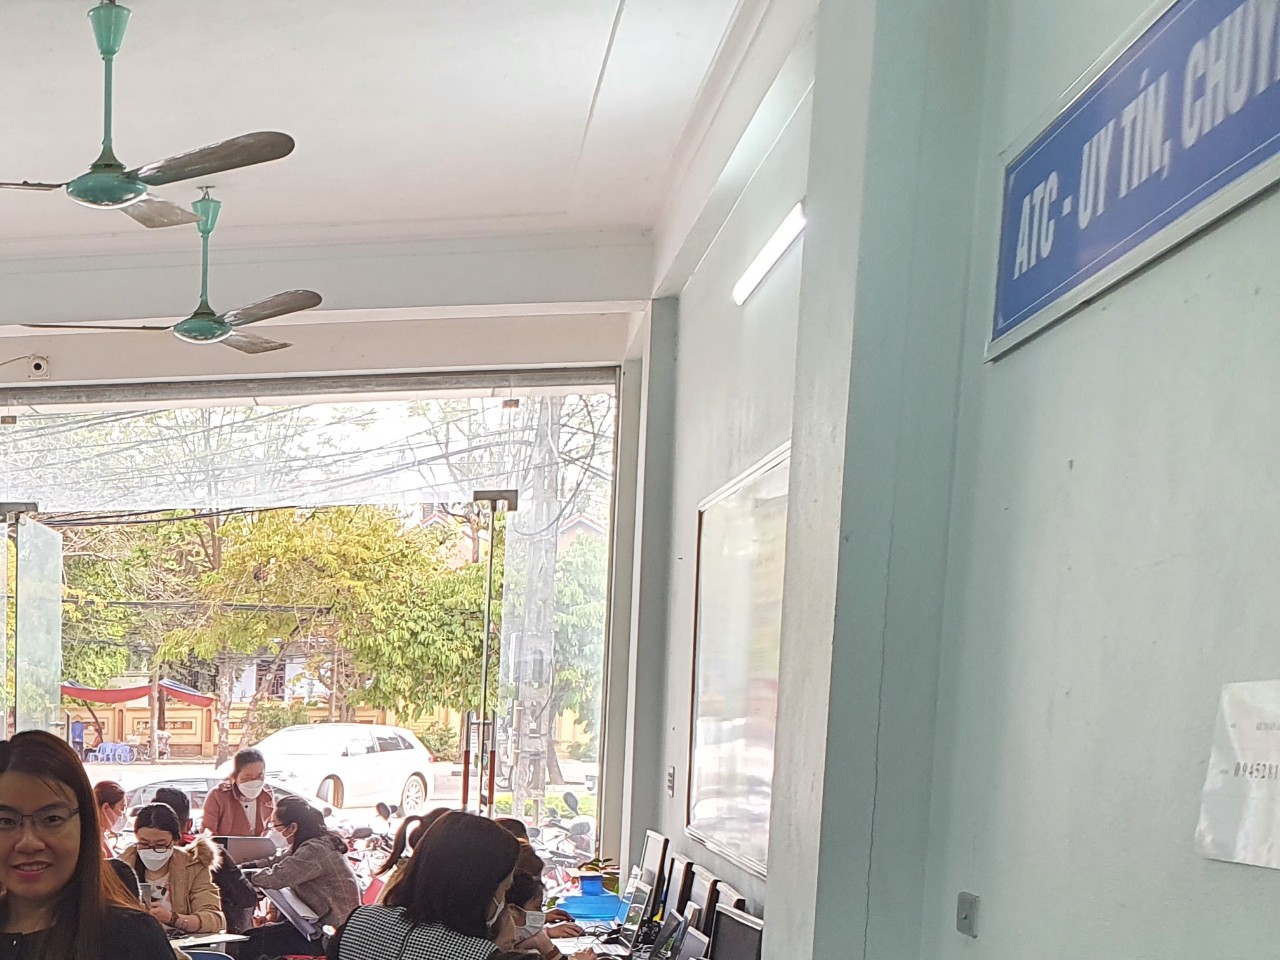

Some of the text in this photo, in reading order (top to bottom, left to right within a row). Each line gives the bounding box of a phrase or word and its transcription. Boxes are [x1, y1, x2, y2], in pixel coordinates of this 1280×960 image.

[1013, 171, 1058, 280] ATC
[1078, 118, 1116, 230] UY
[1119, 67, 1172, 200] TÍN,
[1182, 0, 1280, 149] CHUY
